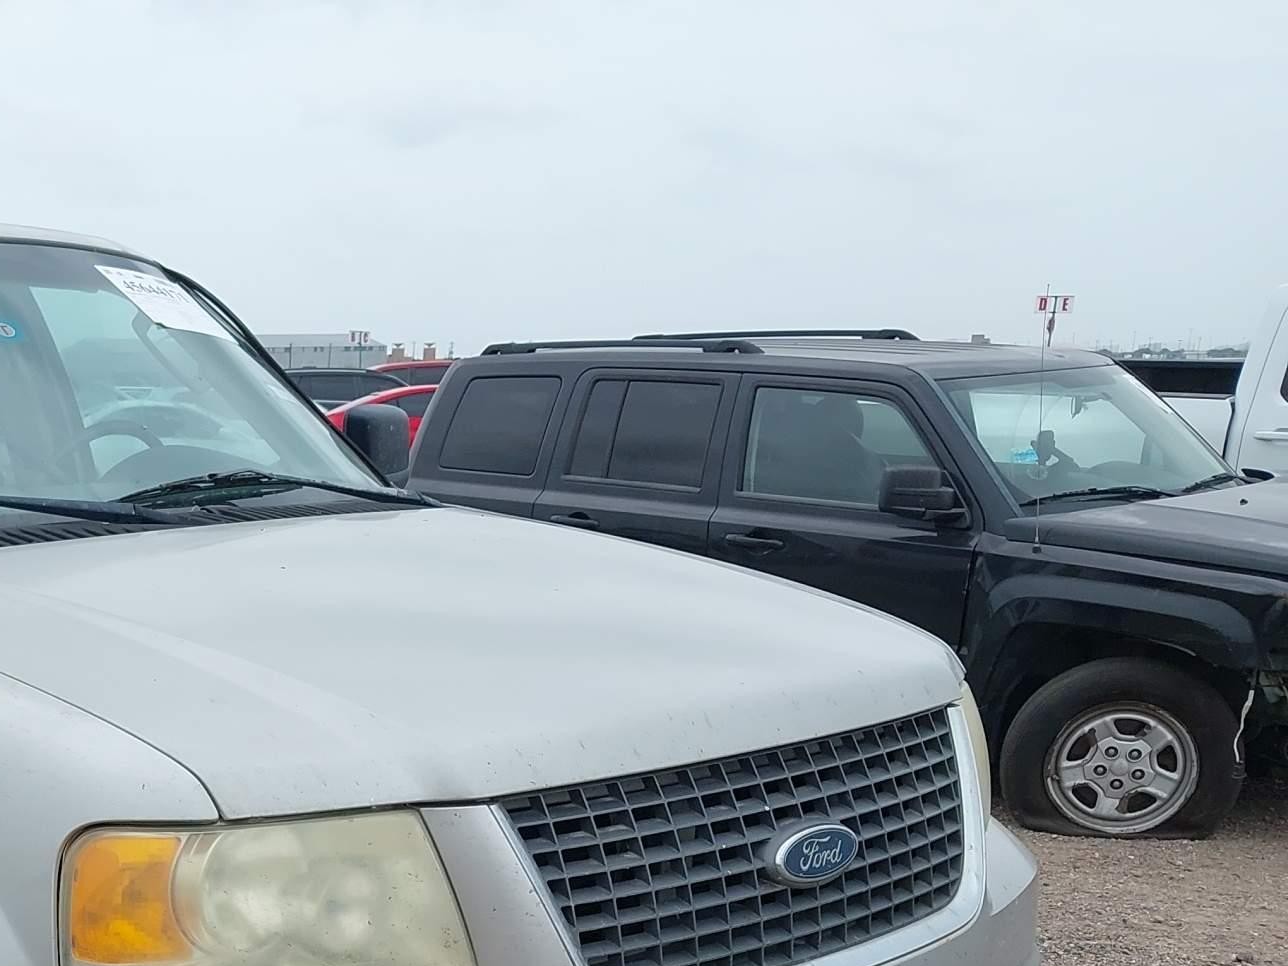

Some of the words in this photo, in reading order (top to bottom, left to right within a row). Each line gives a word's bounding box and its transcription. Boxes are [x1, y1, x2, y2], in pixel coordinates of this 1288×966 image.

[1038, 297, 1048, 311] D
[1062, 297, 1070, 312] E
[800, 835, 843, 871] Ford
